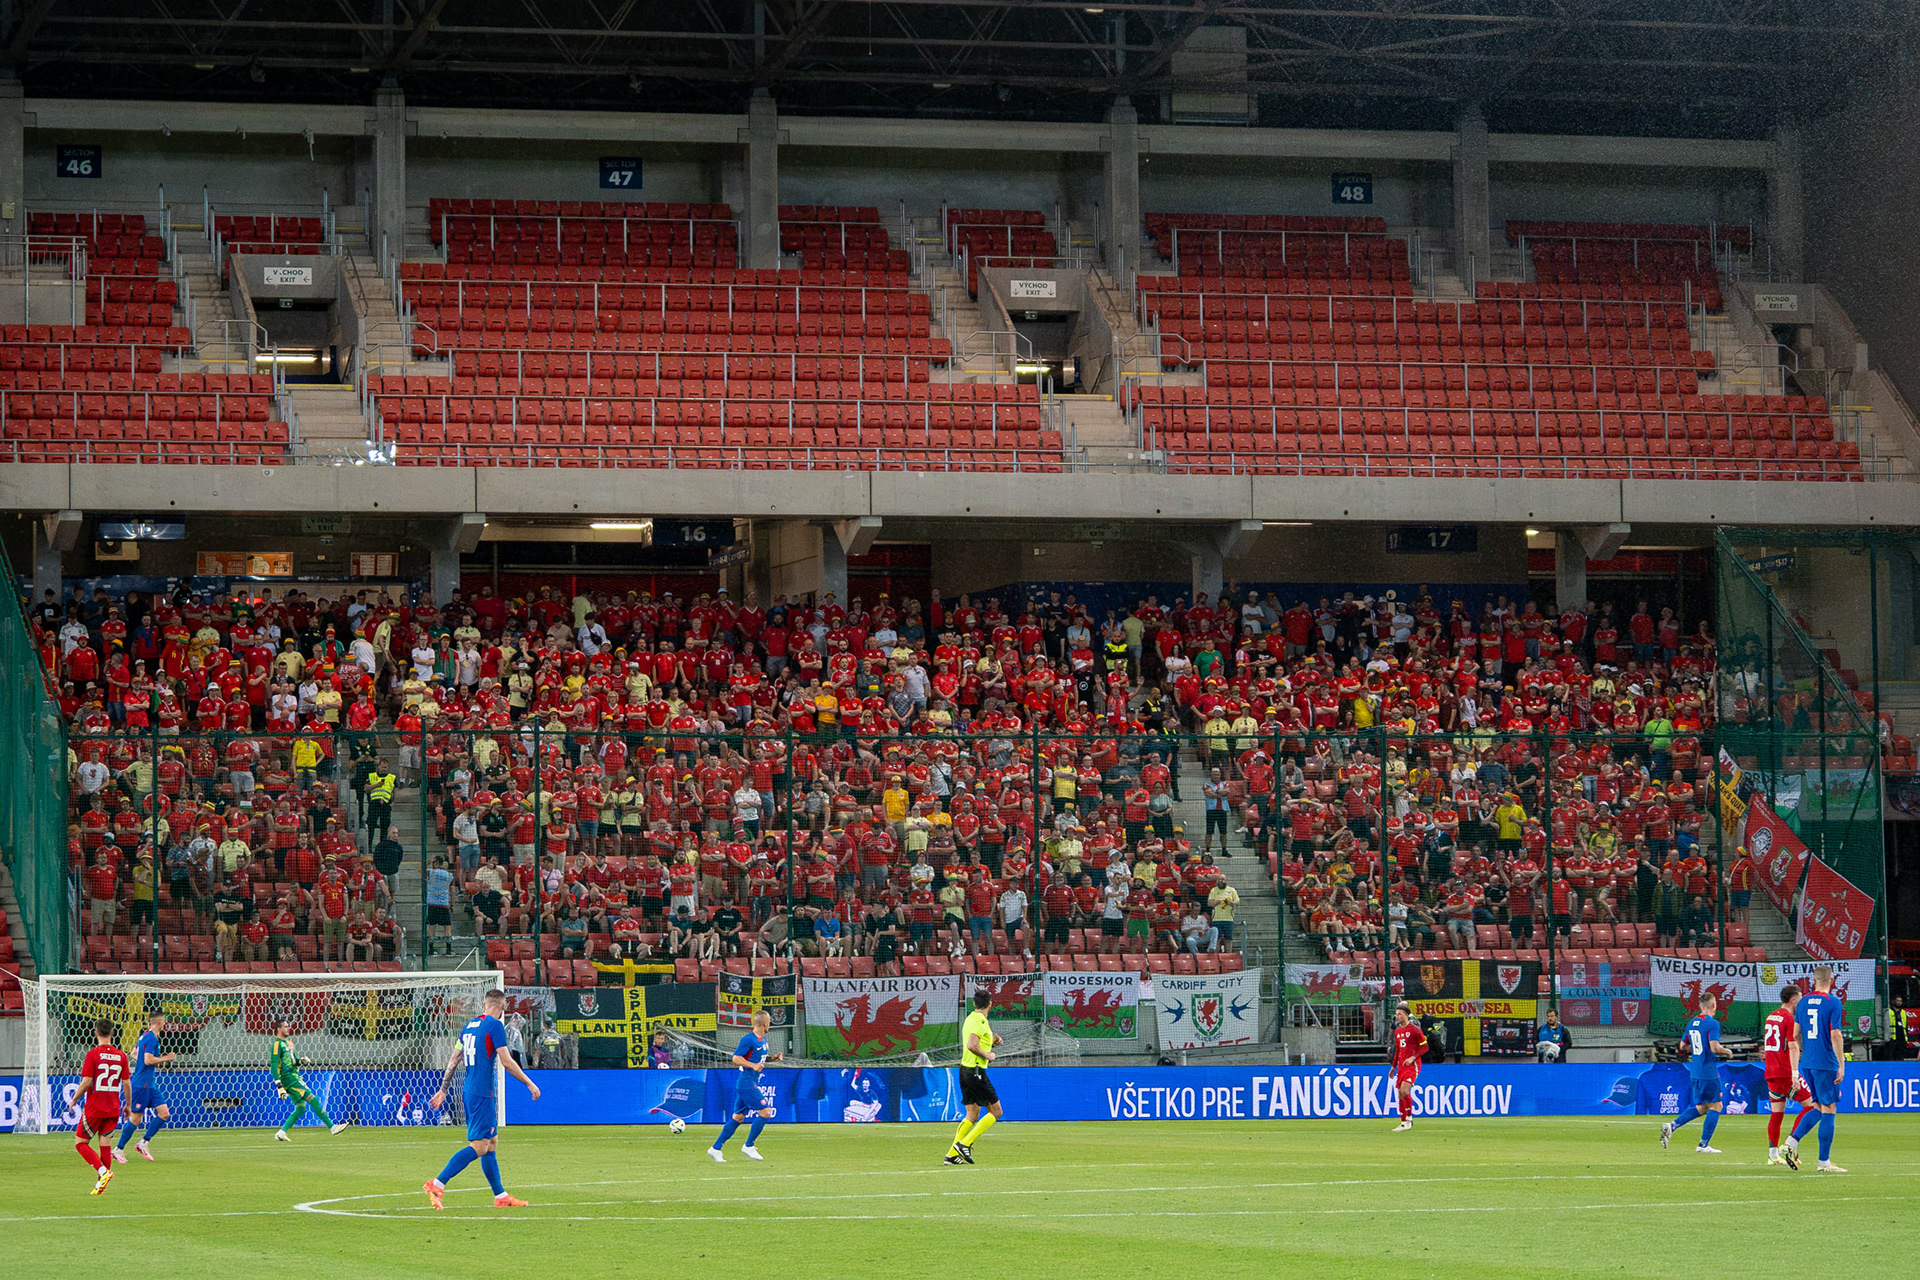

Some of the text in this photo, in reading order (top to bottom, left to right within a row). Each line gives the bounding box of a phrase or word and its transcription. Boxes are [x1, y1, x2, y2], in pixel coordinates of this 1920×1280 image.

[66, 159, 92, 175] 46
[608, 171, 633, 186] 47
[1341, 186, 1365, 201] 48
[681, 525, 706, 542] 16
[1428, 532, 1452, 547] 17
[1730, 796, 1745, 813] QUAY
[1656, 958, 1757, 977] WELSHPOOL
[1782, 963, 1799, 974] ELY
[1838, 962, 1850, 972] FC
[812, 977, 951, 993] LLANFAIR BOYS
[1049, 976, 1133, 985] RHOSESMOR
[1161, 976, 1244, 990] CARDIFF CITY
[726, 994, 789, 1005] TAFFS WELL
[1568, 988, 1642, 997] COLWYN BAY
[1416, 1002, 1513, 1015] RHOS ON SEA
[629, 989, 648, 1066] SPARROW
[1807, 1008, 1819, 1039] 3
[1400, 1038, 1407, 1048] 15
[1689, 1029, 1704, 1056] 19
[1764, 1023, 1781, 1052] 23
[462, 1033, 477, 1067] 14
[95, 1063, 123, 1092] 22
[1106, 1067, 1512, 1118] VŠETKO PRE FANÚŠIKA SOKOLOV
[1854, 1073, 1920, 1108] NÁJDE
